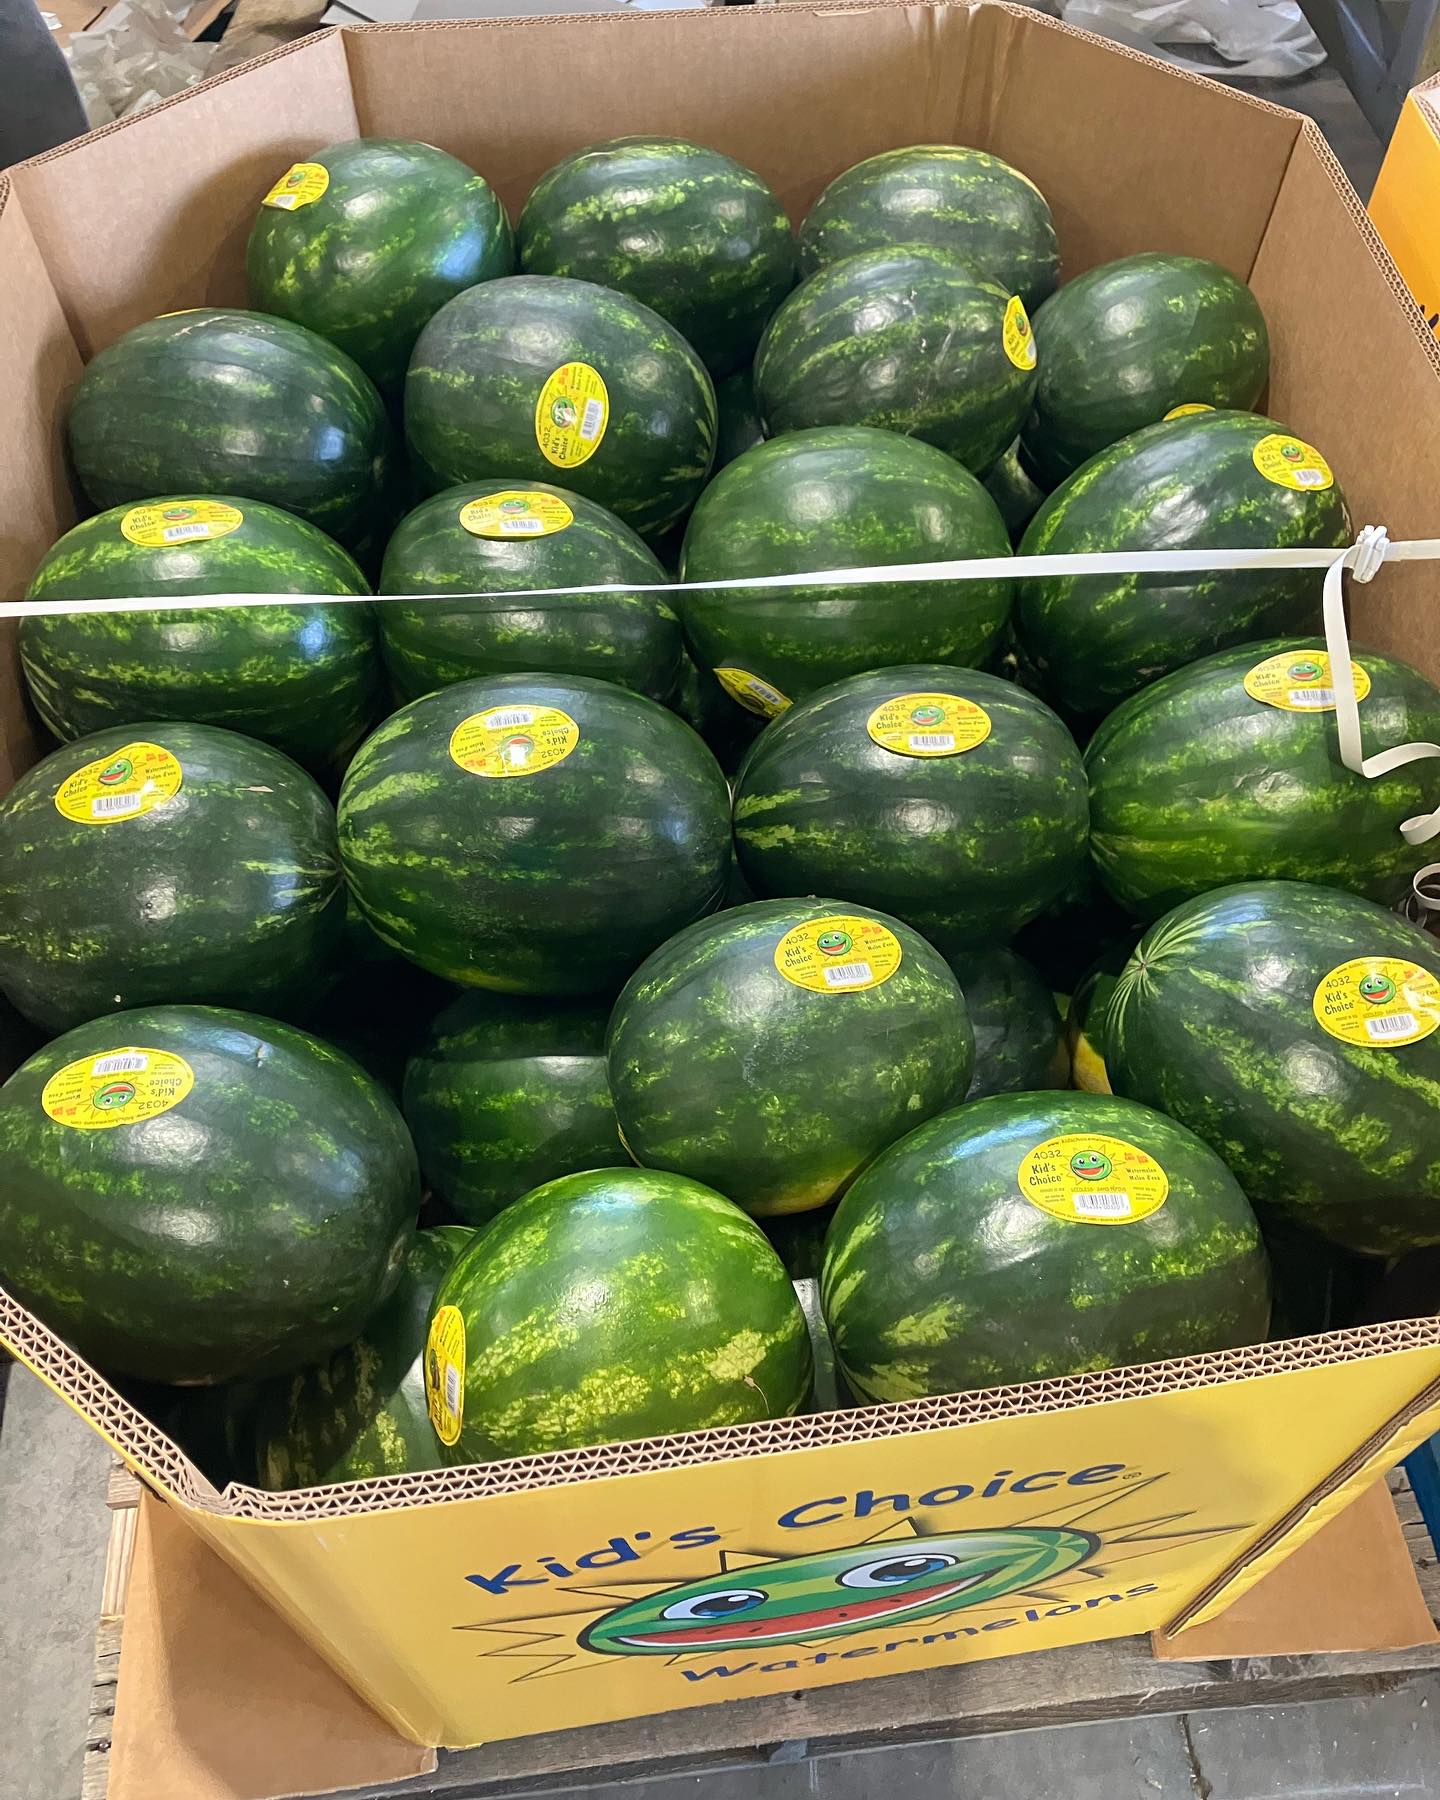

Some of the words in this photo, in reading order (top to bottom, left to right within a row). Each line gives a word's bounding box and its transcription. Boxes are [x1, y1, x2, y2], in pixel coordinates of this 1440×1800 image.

[547, 736, 567, 745] Kid's
[541, 748, 565, 758] 4032
[786, 933, 809, 945] 4032
[785, 946, 806, 957] Kid's
[785, 956, 812, 967] Choice
[1326, 976, 1350, 988] 4032
[1325, 991, 1348, 1003] Kid's
[1325, 1002, 1354, 1015] Choice
[150, 1078, 182, 1086] Choice
[151, 1088, 175, 1097] Kid's
[139, 1100, 168, 1109] 4032
[1033, 1150, 1062, 1160] 4032
[1032, 1162, 1056, 1174] Kid's
[1030, 1176, 1061, 1186] Choice
[465, 1525, 721, 1595] Kid's
[681, 1581, 1159, 1682] Watermelons
